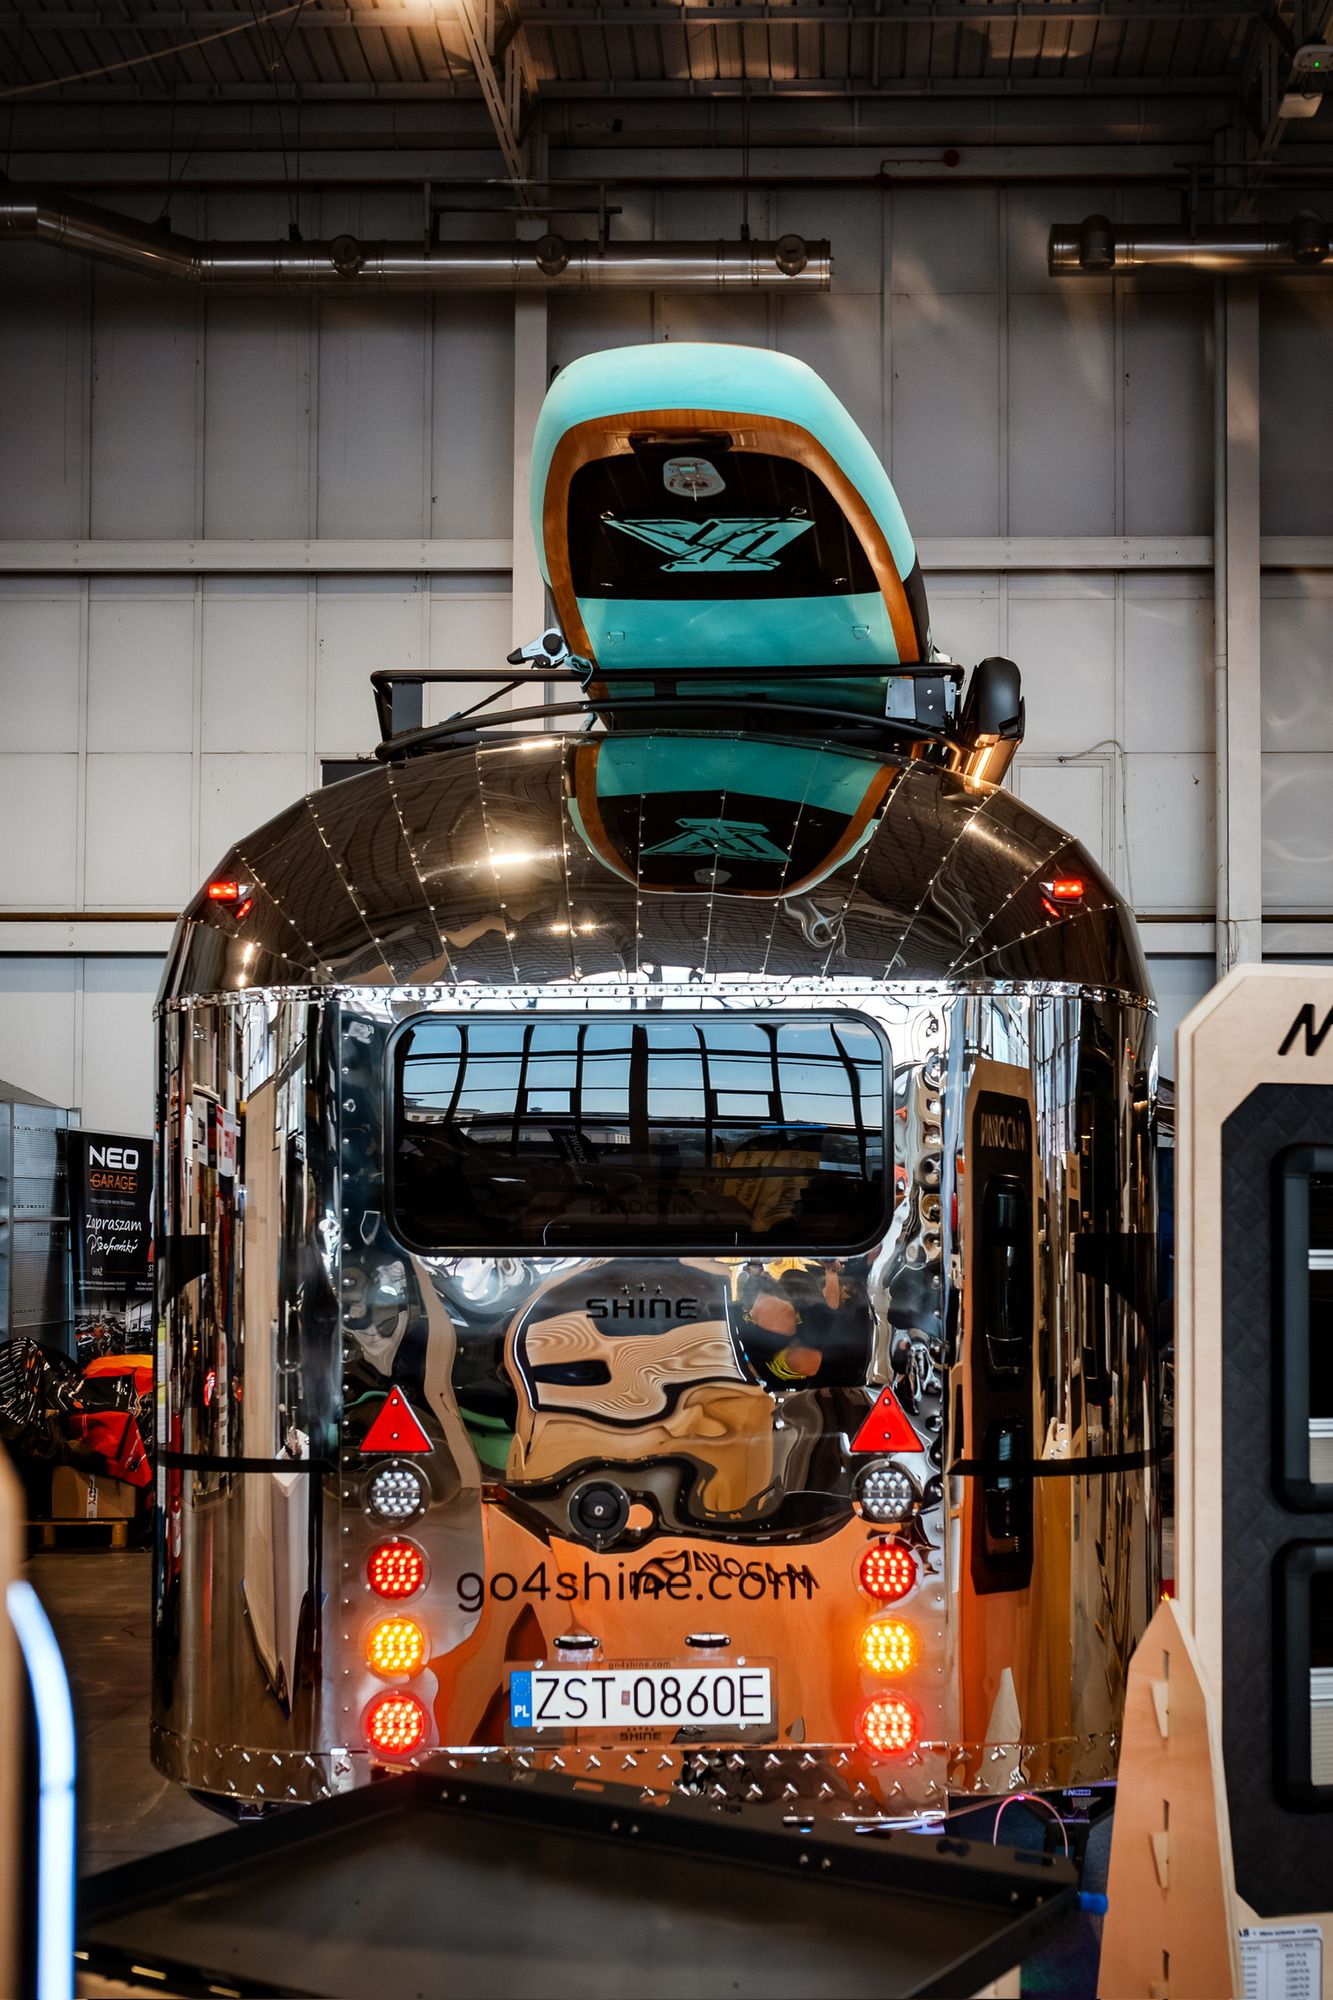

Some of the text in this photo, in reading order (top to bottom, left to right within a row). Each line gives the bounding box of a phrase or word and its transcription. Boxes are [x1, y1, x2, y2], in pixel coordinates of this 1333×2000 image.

[89, 1145, 139, 1170] NEO
[91, 1172, 136, 1191] GARAGE
[86, 1214, 142, 1235] Zapraszam
[586, 1298, 698, 1318] SHINE
[457, 1561, 813, 1613] go4shine.com
[608, 1660, 671, 1670] go4shine.com
[536, 1675, 764, 1720] ZST 0860E
[514, 1704, 530, 1718] PL
[620, 1731, 662, 1741] SHINE
